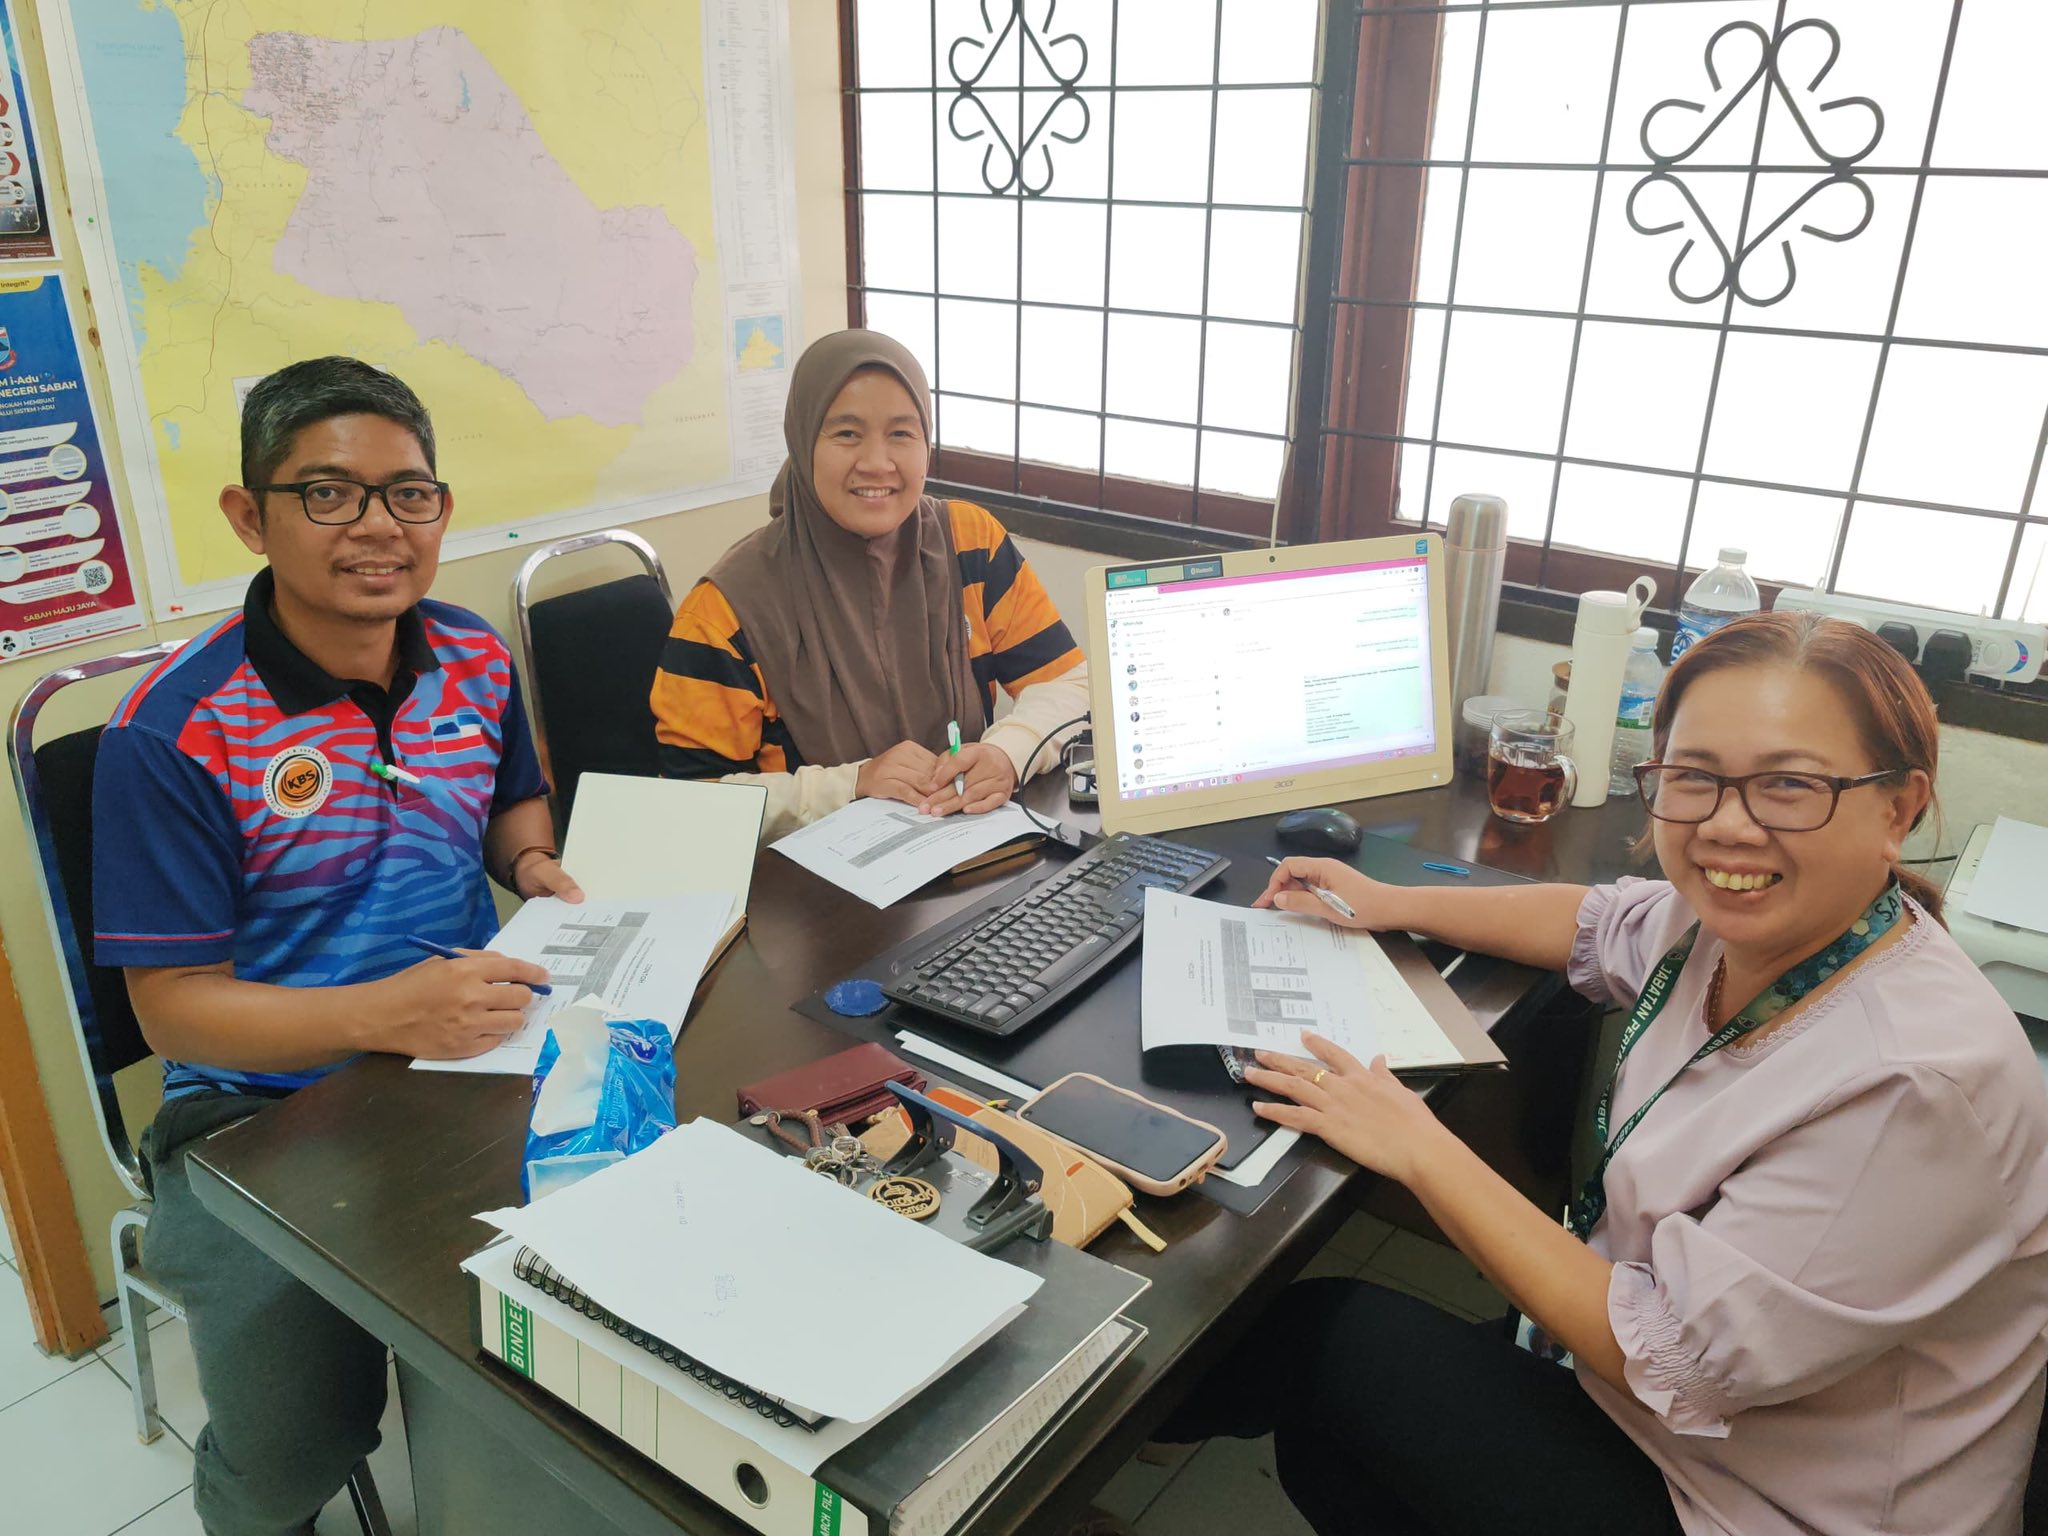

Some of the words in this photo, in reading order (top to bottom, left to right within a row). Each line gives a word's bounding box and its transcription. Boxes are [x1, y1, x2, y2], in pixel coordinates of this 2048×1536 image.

[39, 380, 77, 393] SABAH
[23, 609, 52, 623] SABAH
[53, 605, 76, 617] MAJU
[76, 600, 97, 611] JAYA
[287, 769, 316, 790] KBS
[1636, 964, 1673, 1021] JABATAN
[1699, 1027, 1740, 1057] SABAH
[821, 1490, 833, 1512] FILE
